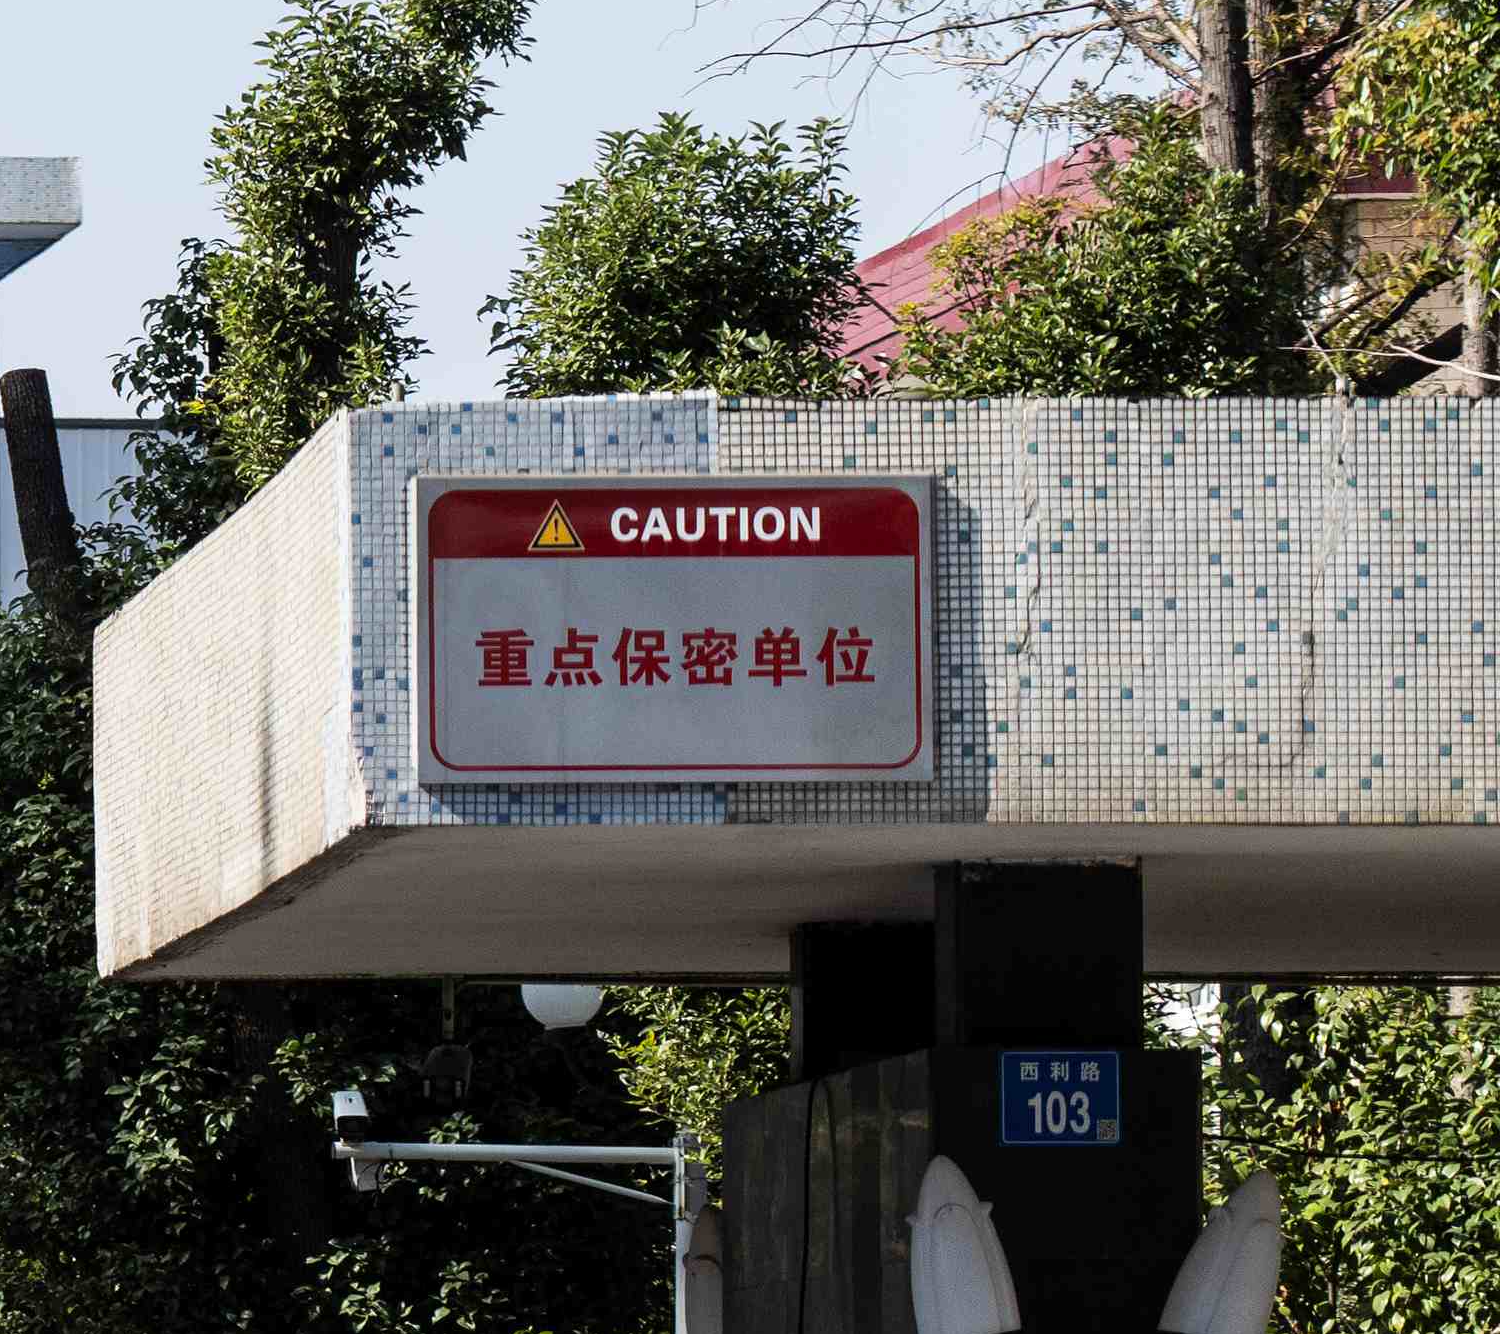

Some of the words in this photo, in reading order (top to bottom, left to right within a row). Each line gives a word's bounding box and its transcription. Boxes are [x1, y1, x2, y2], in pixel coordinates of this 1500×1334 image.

[610, 506, 821, 542] CAUTION
[475, 626, 876, 688] 重点保密单位
[1020, 1061, 1100, 1082] 西利路
[1028, 1090, 1091, 1134] 103
